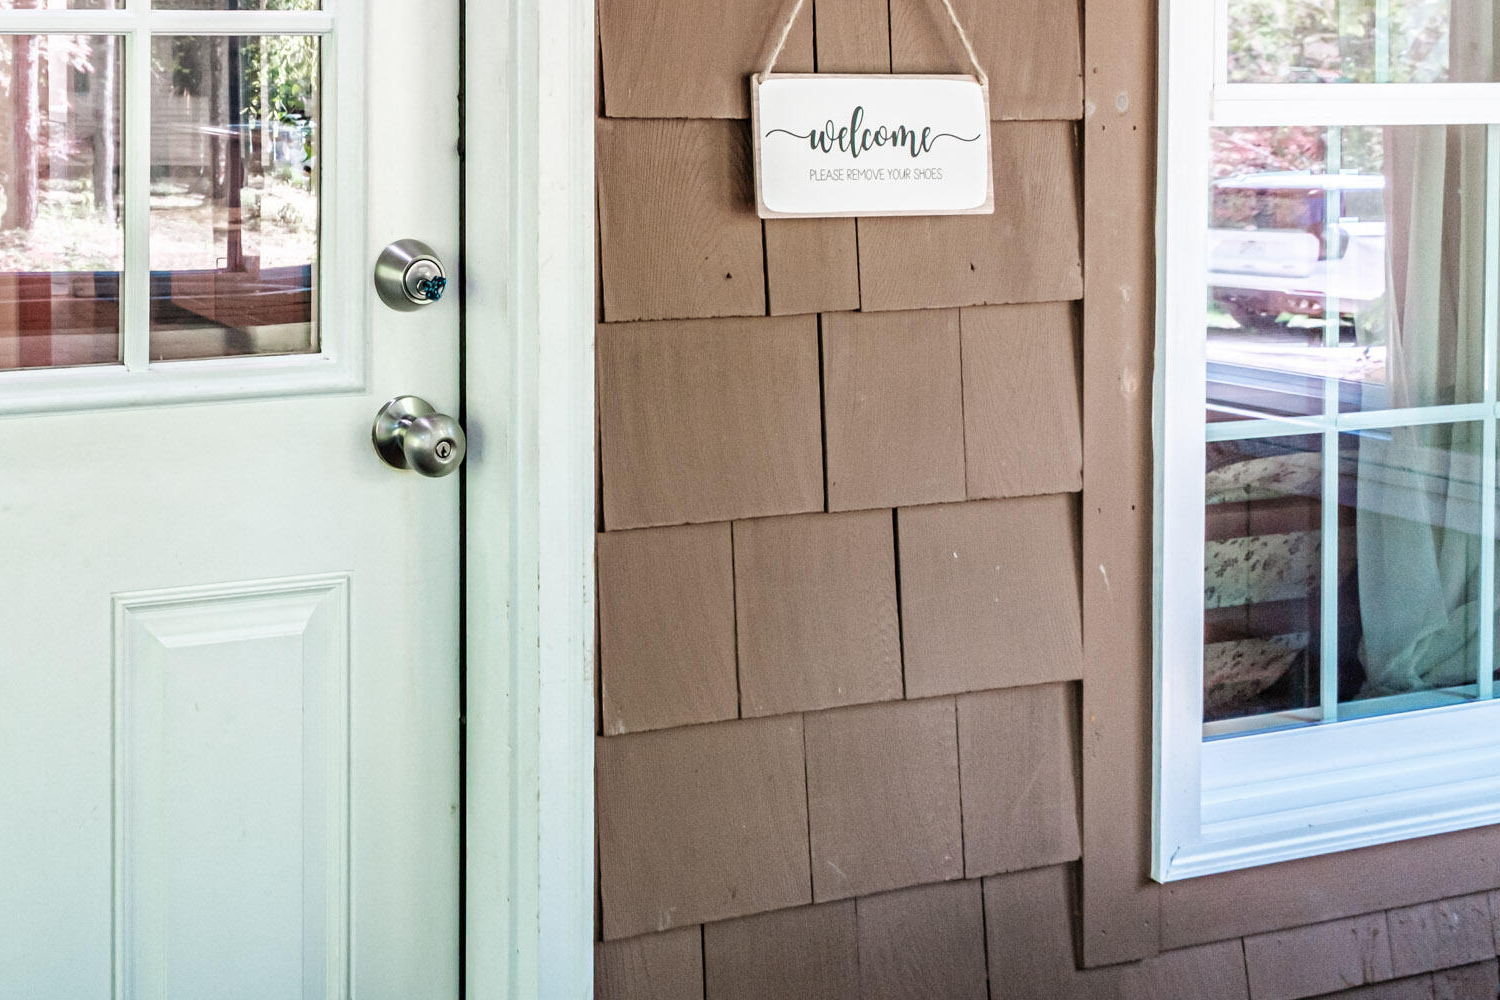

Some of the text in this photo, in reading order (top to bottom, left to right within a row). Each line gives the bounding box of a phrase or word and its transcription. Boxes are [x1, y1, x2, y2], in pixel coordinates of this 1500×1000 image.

[805, 105, 938, 158] welcome
[809, 167, 943, 181] PLEASE REMOVE YOUR SHOES
